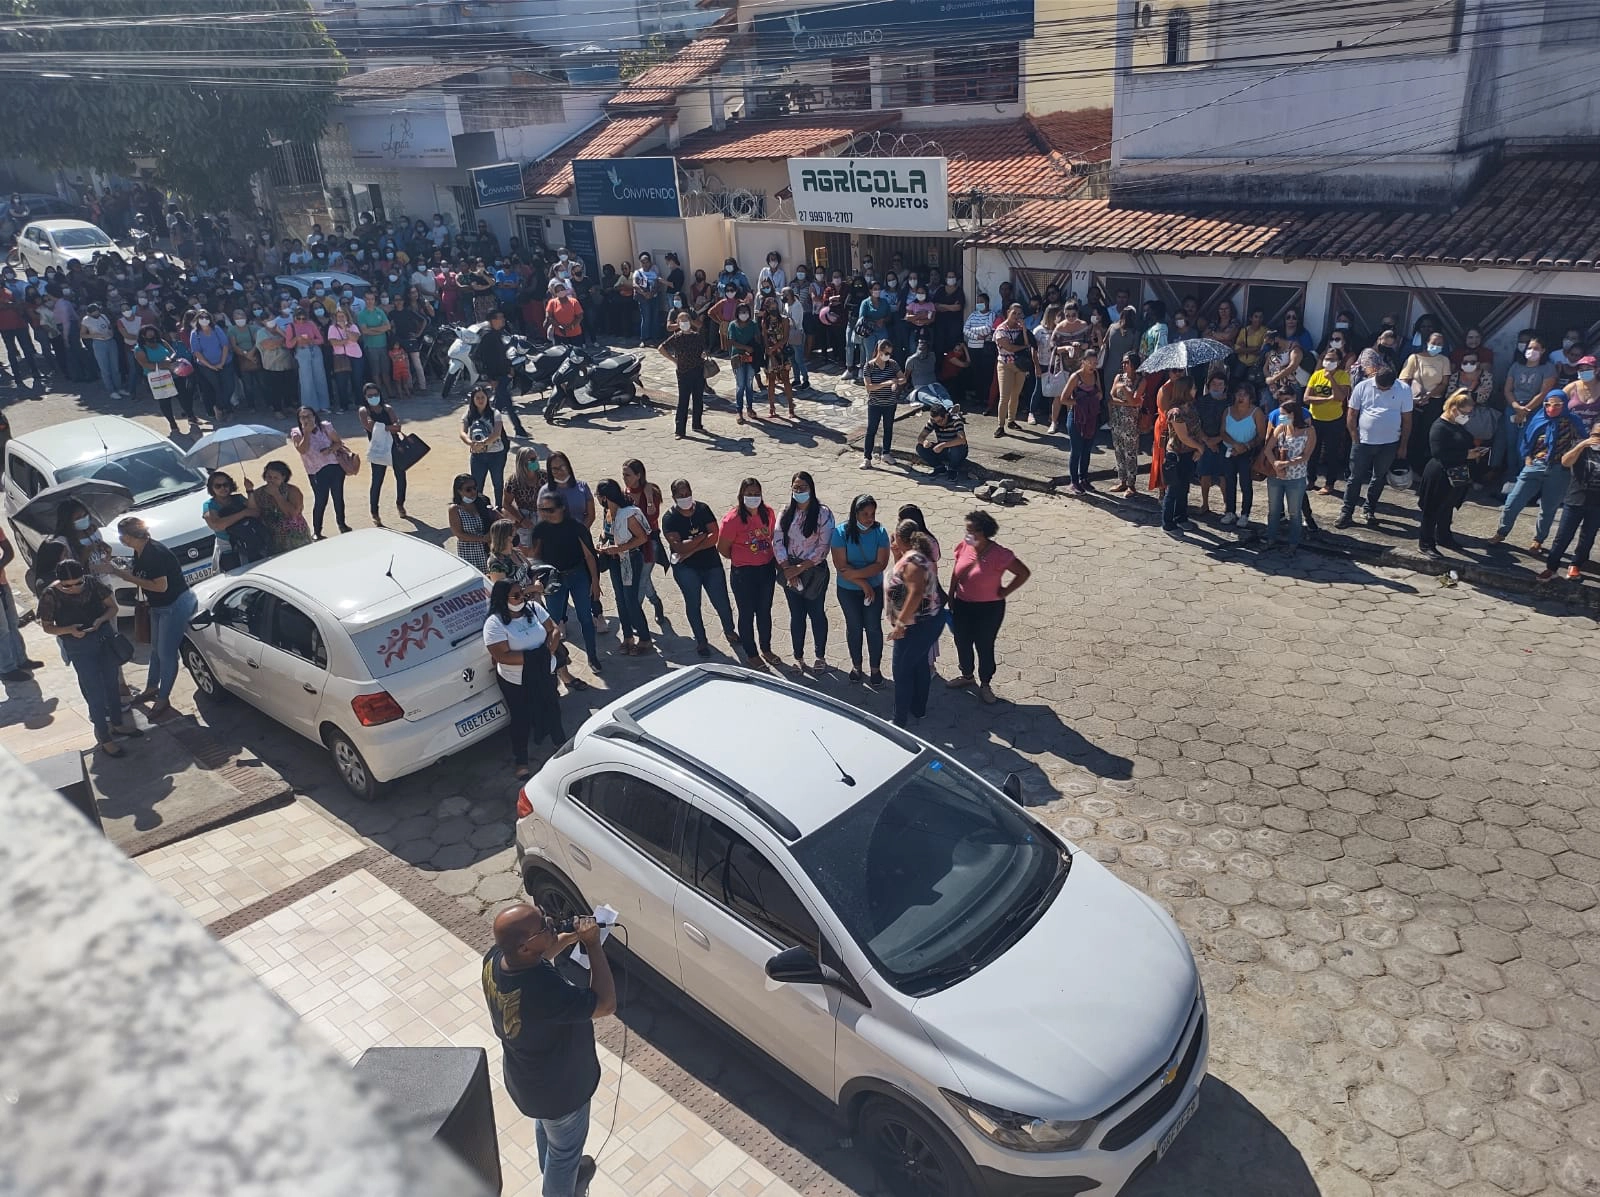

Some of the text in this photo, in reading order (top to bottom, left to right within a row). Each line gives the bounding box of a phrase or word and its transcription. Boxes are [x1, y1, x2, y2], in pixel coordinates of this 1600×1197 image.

[801, 160, 927, 194] AGRÍCOLA
[613, 184, 676, 200] CONVIVENDO
[870, 197, 929, 209] PROJETOS
[798, 211, 853, 223] 27 99978-2707
[1074, 270, 1087, 280] 77
[460, 706, 501, 733] RBE7E84
